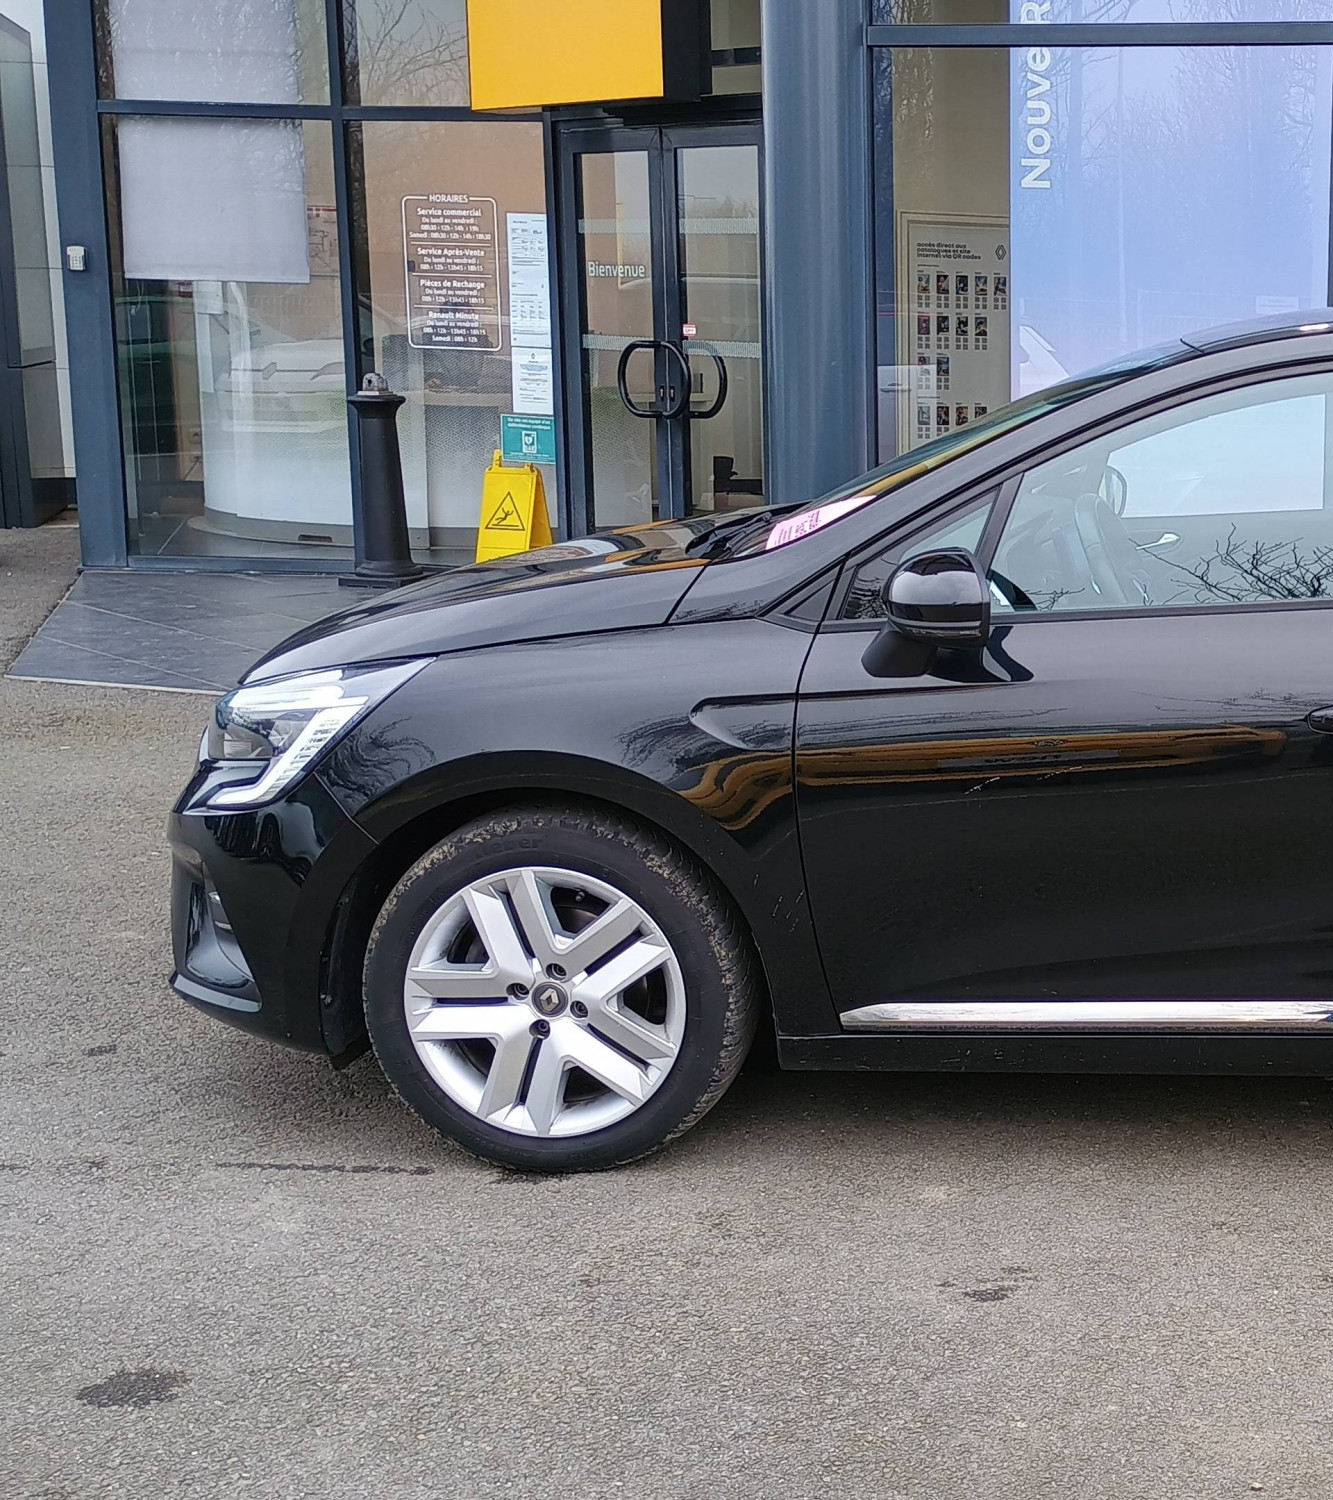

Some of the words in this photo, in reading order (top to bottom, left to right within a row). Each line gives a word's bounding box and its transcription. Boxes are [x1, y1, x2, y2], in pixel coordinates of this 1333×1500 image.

[429, 194, 468, 203] HORAIRES
[417, 208, 442, 216] Service
[443, 208, 482, 216] commercial
[443, 248, 484, 256] Après-Vente
[588, 262, 646, 278] Bienvenue
[420, 279, 441, 287] Pièces
[453, 280, 484, 289] Rechange
[429, 311, 454, 319] Renault
